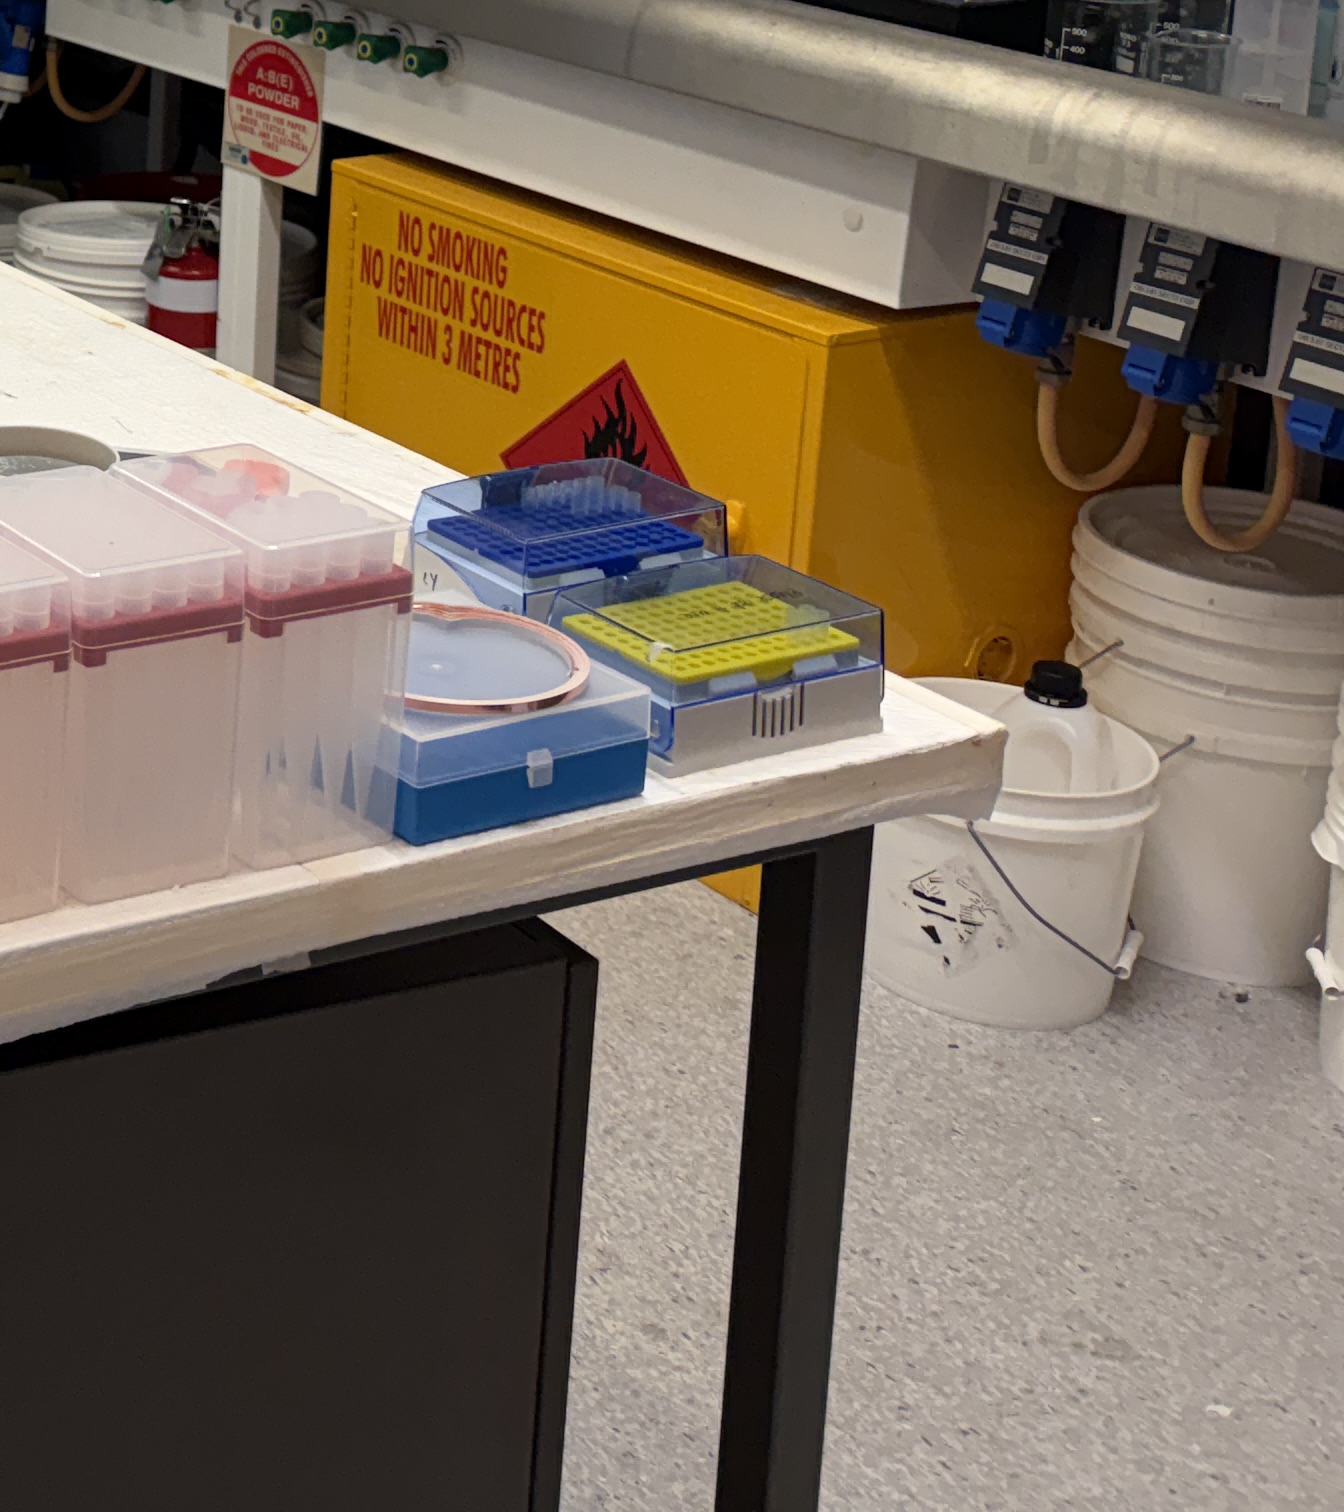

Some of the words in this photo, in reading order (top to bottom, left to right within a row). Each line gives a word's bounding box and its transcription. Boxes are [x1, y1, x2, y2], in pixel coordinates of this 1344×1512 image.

[248, 82, 301, 111] POWDER
[398, 209, 423, 257] NO
[427, 221, 508, 289] SMOKING
[360, 242, 384, 289] NO
[388, 254, 465, 323] IGNITION
[470, 286, 546, 354] SOURCES
[377, 295, 438, 360] WITHIN
[442, 323, 453, 366] 3
[457, 329, 521, 394] METRES
